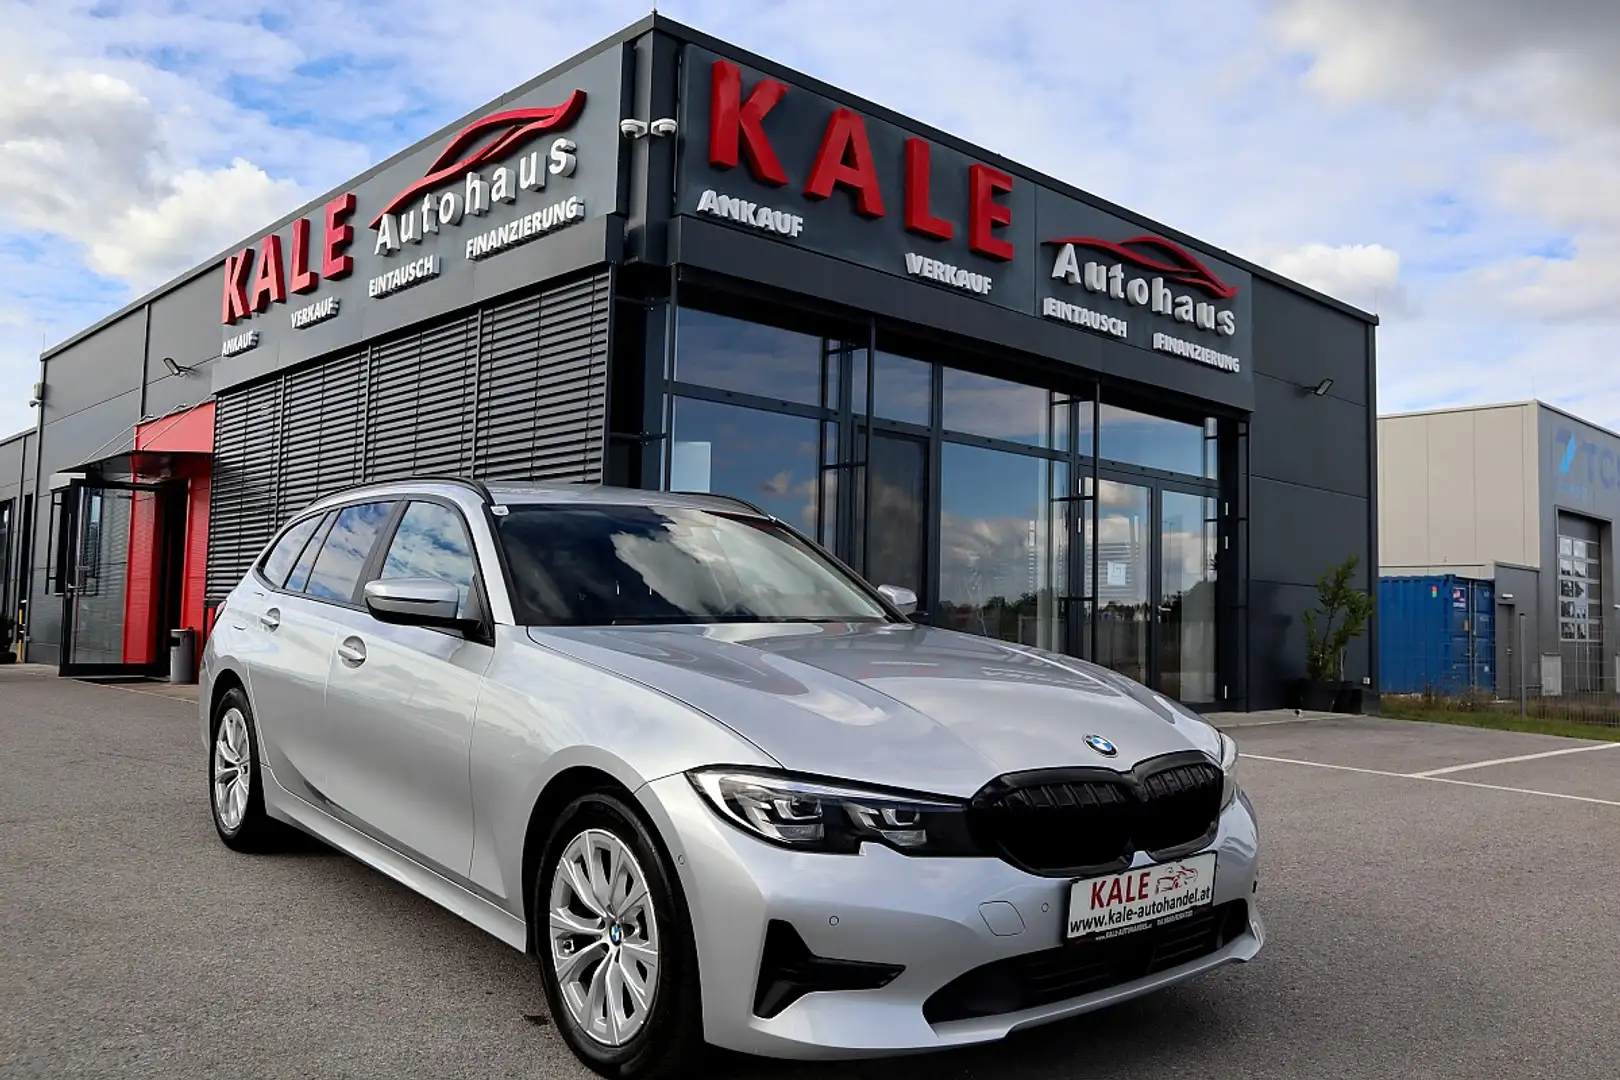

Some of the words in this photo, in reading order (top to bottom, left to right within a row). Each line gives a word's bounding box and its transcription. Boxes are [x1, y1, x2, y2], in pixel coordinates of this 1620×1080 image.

[709, 59, 1014, 261] KALE
[374, 138, 578, 256] Autohaus
[697, 189, 805, 237] ANKAUF
[466, 195, 585, 260] FINANZIERUNG
[222, 193, 356, 325] KALE
[369, 254, 440, 298] EINTAUSCH
[904, 252, 992, 295] VERKAUF
[291, 296, 340, 329] VERKAUF
[1051, 243, 1235, 335] Autohaus
[1043, 297, 1127, 339] EINTAUSCH
[222, 329, 259, 357] ANKAUF
[1152, 332, 1240, 373] FINANZIERUNG
[1579, 441, 1620, 490] TC
[1070, 886, 1210, 933] www.kale-autohandel.at
[1090, 871, 1150, 910] KALE
